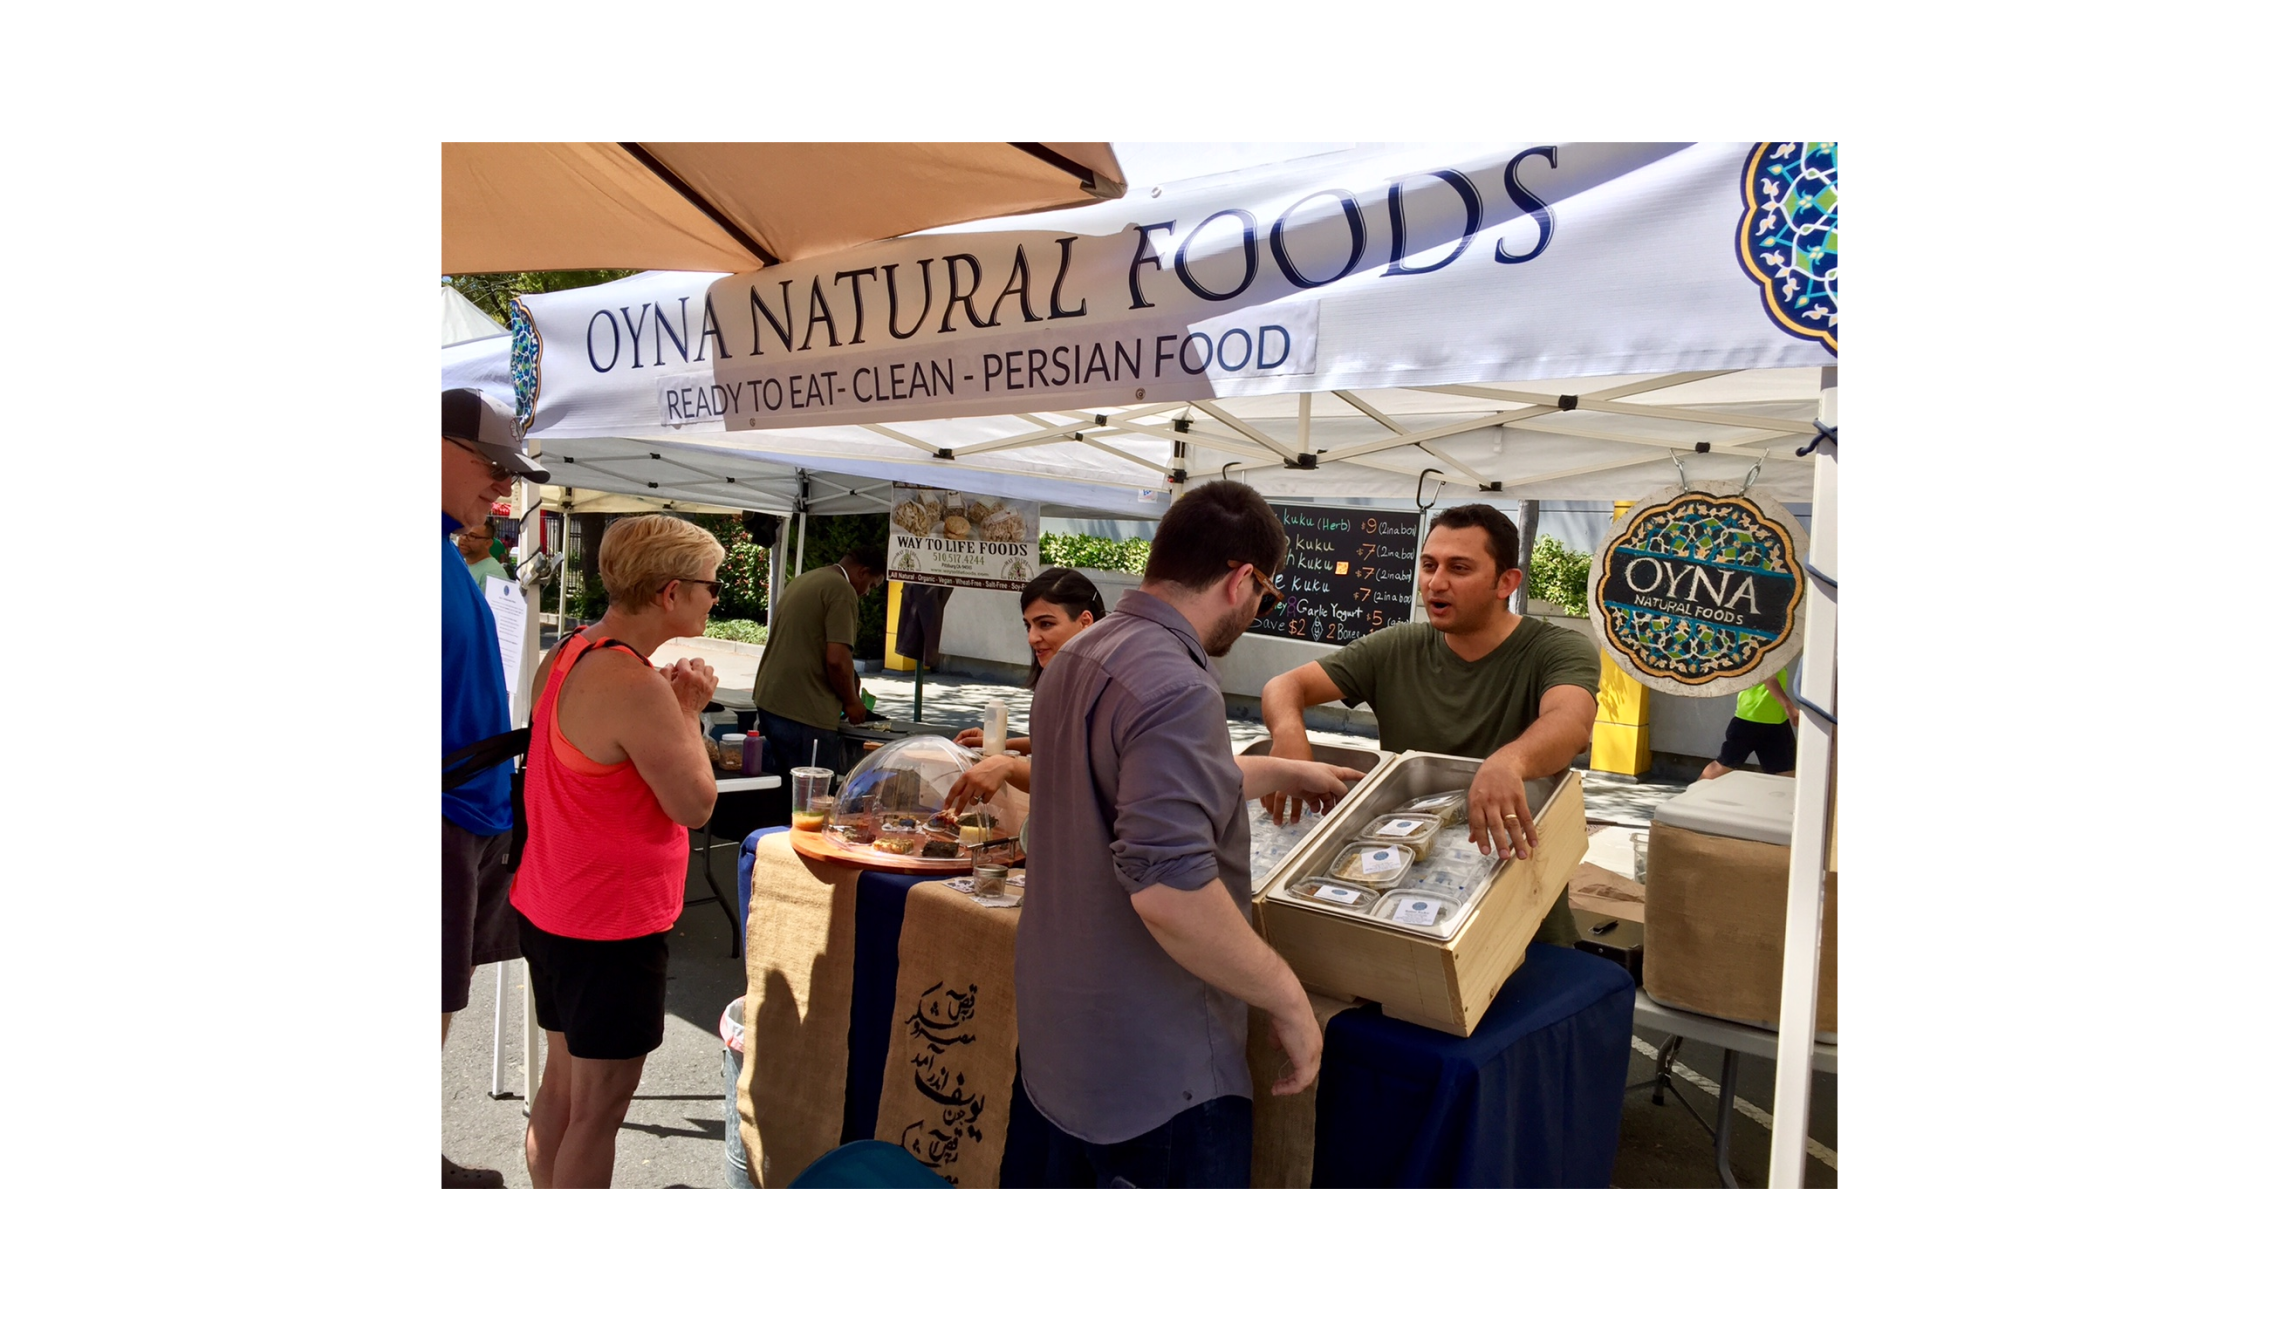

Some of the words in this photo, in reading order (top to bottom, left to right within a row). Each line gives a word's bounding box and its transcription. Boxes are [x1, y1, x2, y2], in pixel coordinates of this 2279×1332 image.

[587, 292, 733, 373] OYNA
[749, 236, 1087, 356] NATURAL
[1128, 144, 1558, 309] FOODS
[666, 381, 743, 420] READY
[747, 378, 783, 413] TO
[853, 358, 955, 403] CLEAN
[983, 338, 1143, 392] PERSIAN
[1154, 324, 1291, 378] FOOD
[1284, 508, 1314, 528] kuku
[1317, 519, 1351, 533] (Herb)
[897, 536, 922, 549] WAY
[925, 538, 942, 551] TO
[945, 540, 975, 554] LIFE
[979, 543, 1028, 557] FOODS
[932, 552, 985, 565] 510.517.4244
[890, 571, 898, 579] All
[899, 572, 915, 580] Natural
[917, 574, 936, 583] Organic
[938, 575, 953, 585] Vegan
[955, 577, 982, 588] Wheat-Free
[985, 580, 1008, 590] Salt-Free
[1625, 557, 1761, 615] OYNA
[1296, 598, 1328, 617] Garlic
[1330, 603, 1363, 622] Yogurt
[1366, 610, 1383, 626] $5
[1634, 594, 1692, 617] NATURAL
[1695, 606, 1744, 625] FOODS
[1288, 618, 1306, 636] $2
[1326, 623, 1336, 639] 2
